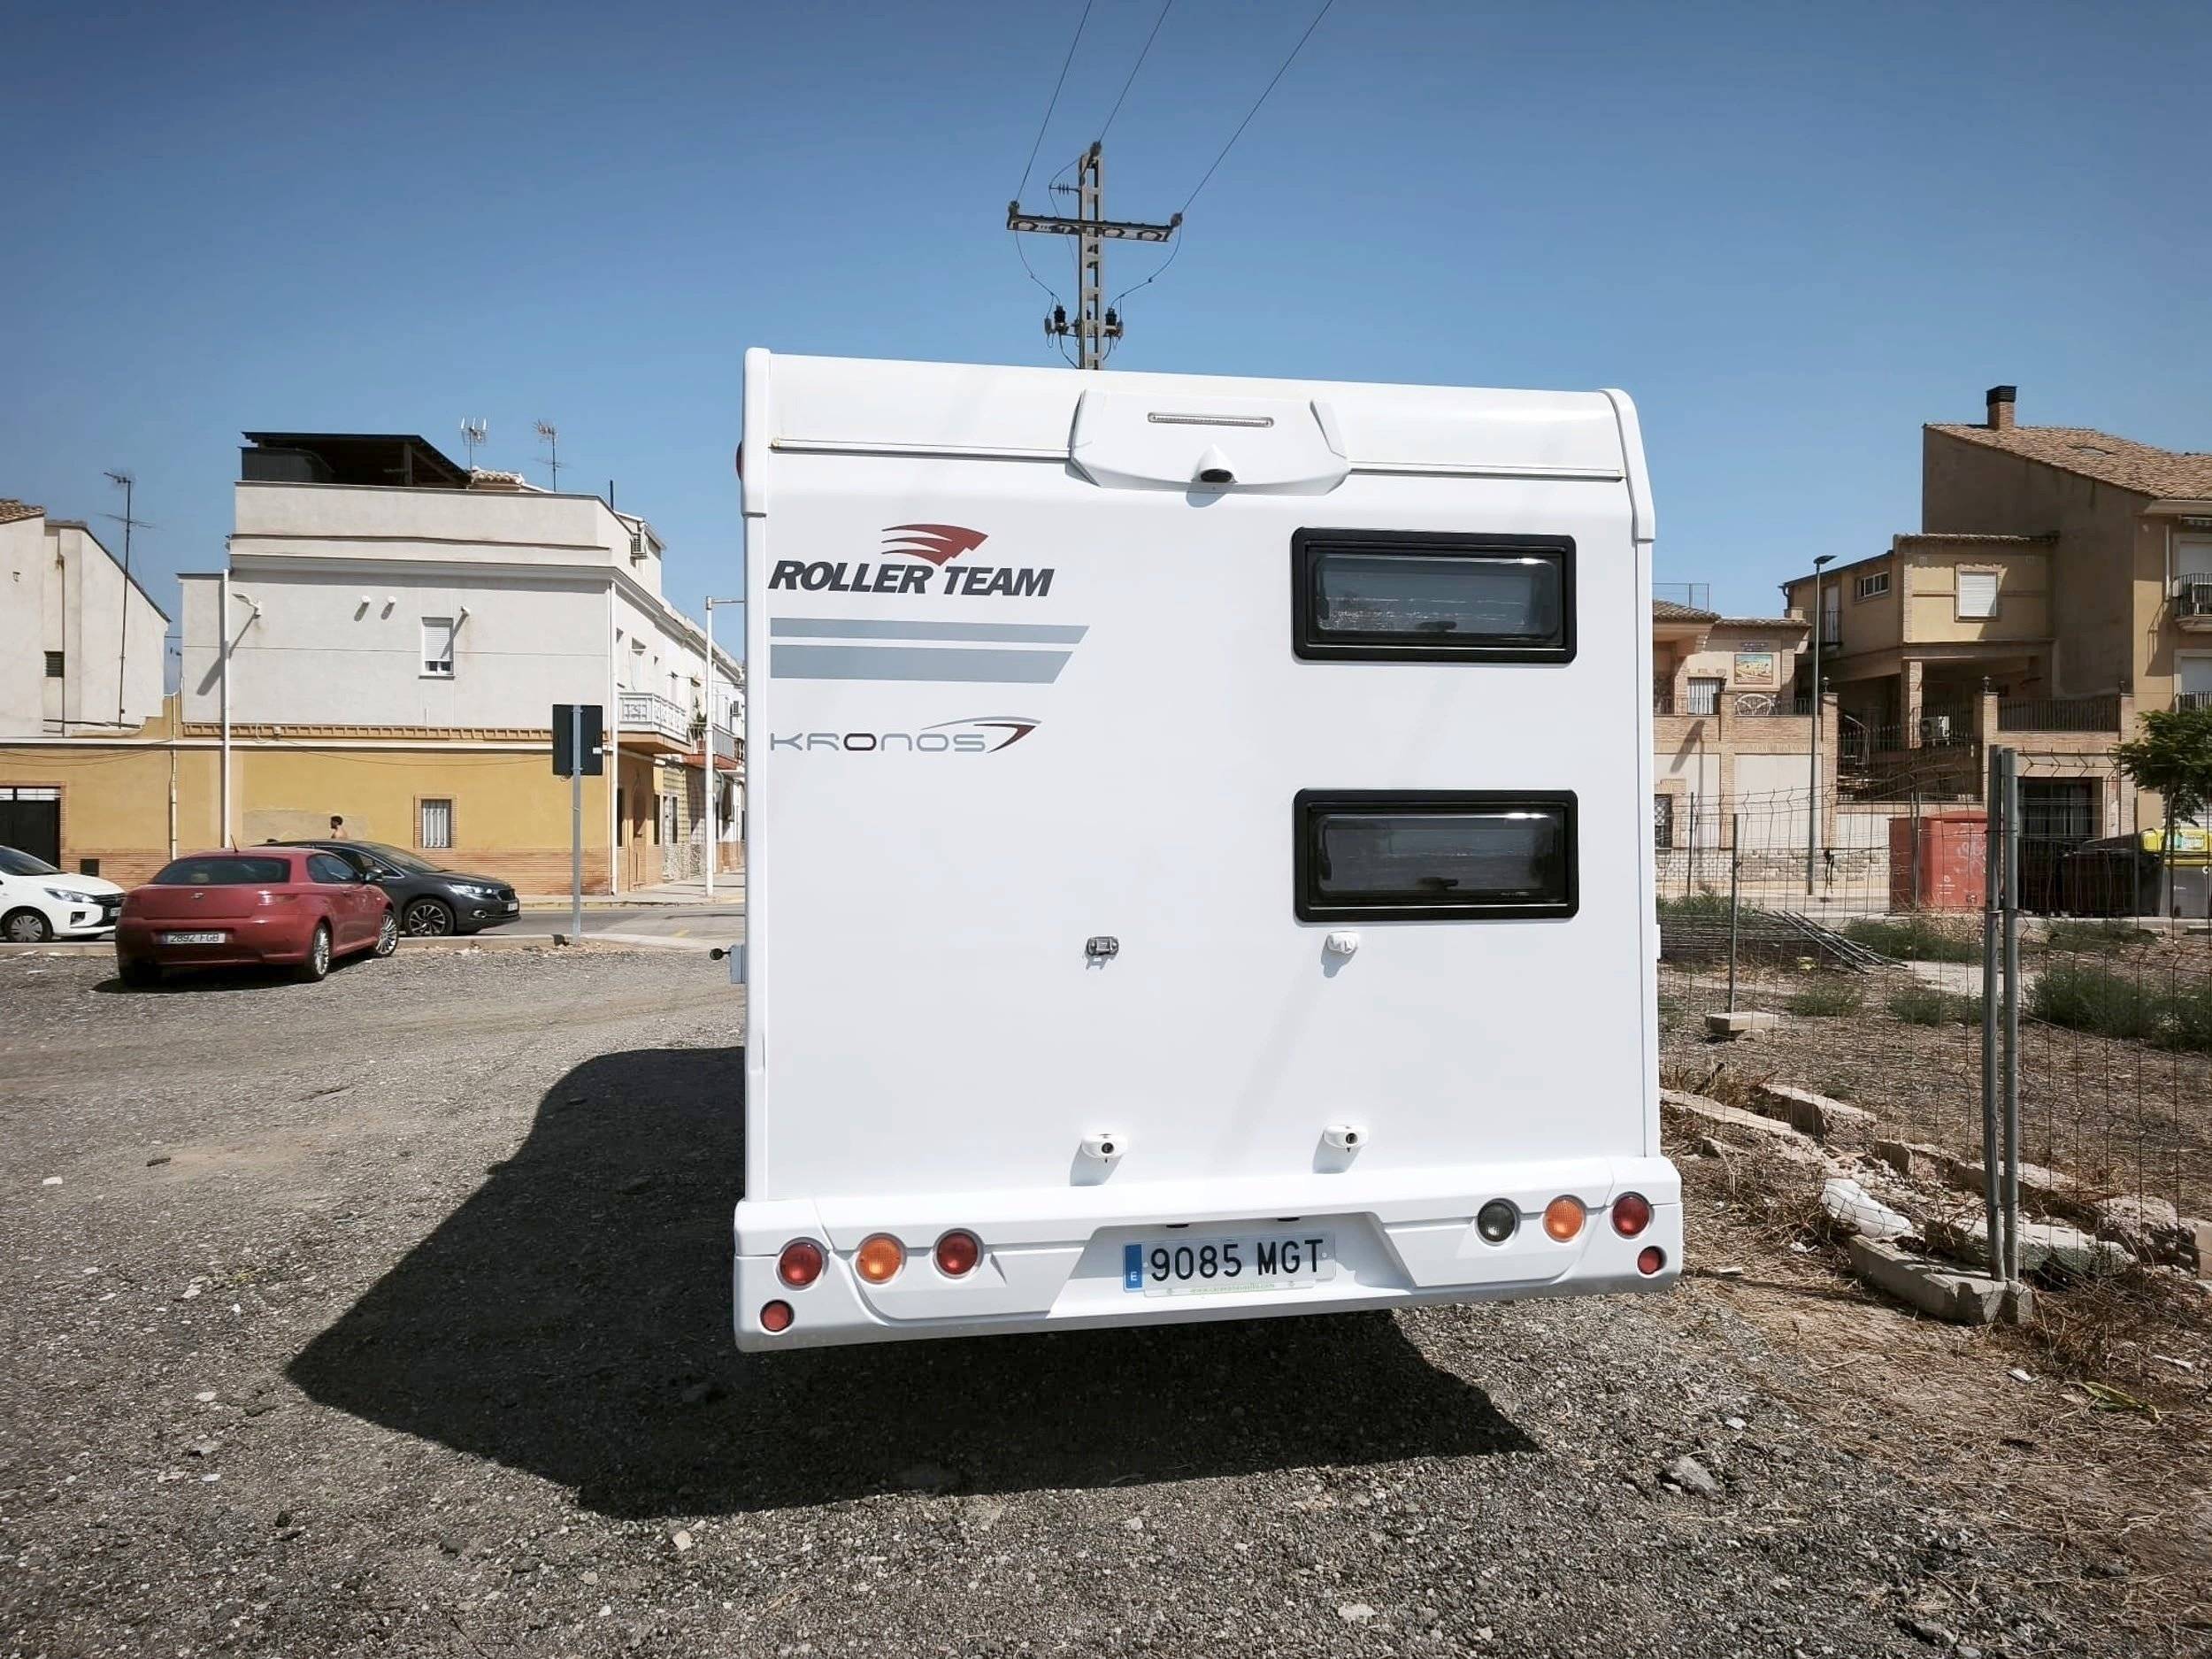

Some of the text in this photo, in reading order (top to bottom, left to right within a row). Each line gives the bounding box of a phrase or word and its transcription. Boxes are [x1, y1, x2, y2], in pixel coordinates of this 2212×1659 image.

[768, 560, 1055, 597] ROLLER TEAM
[770, 732, 987, 752] KRONOS
[1150, 1239, 1324, 1281] 9085 MGT
[1130, 1272, 1137, 1281] E
